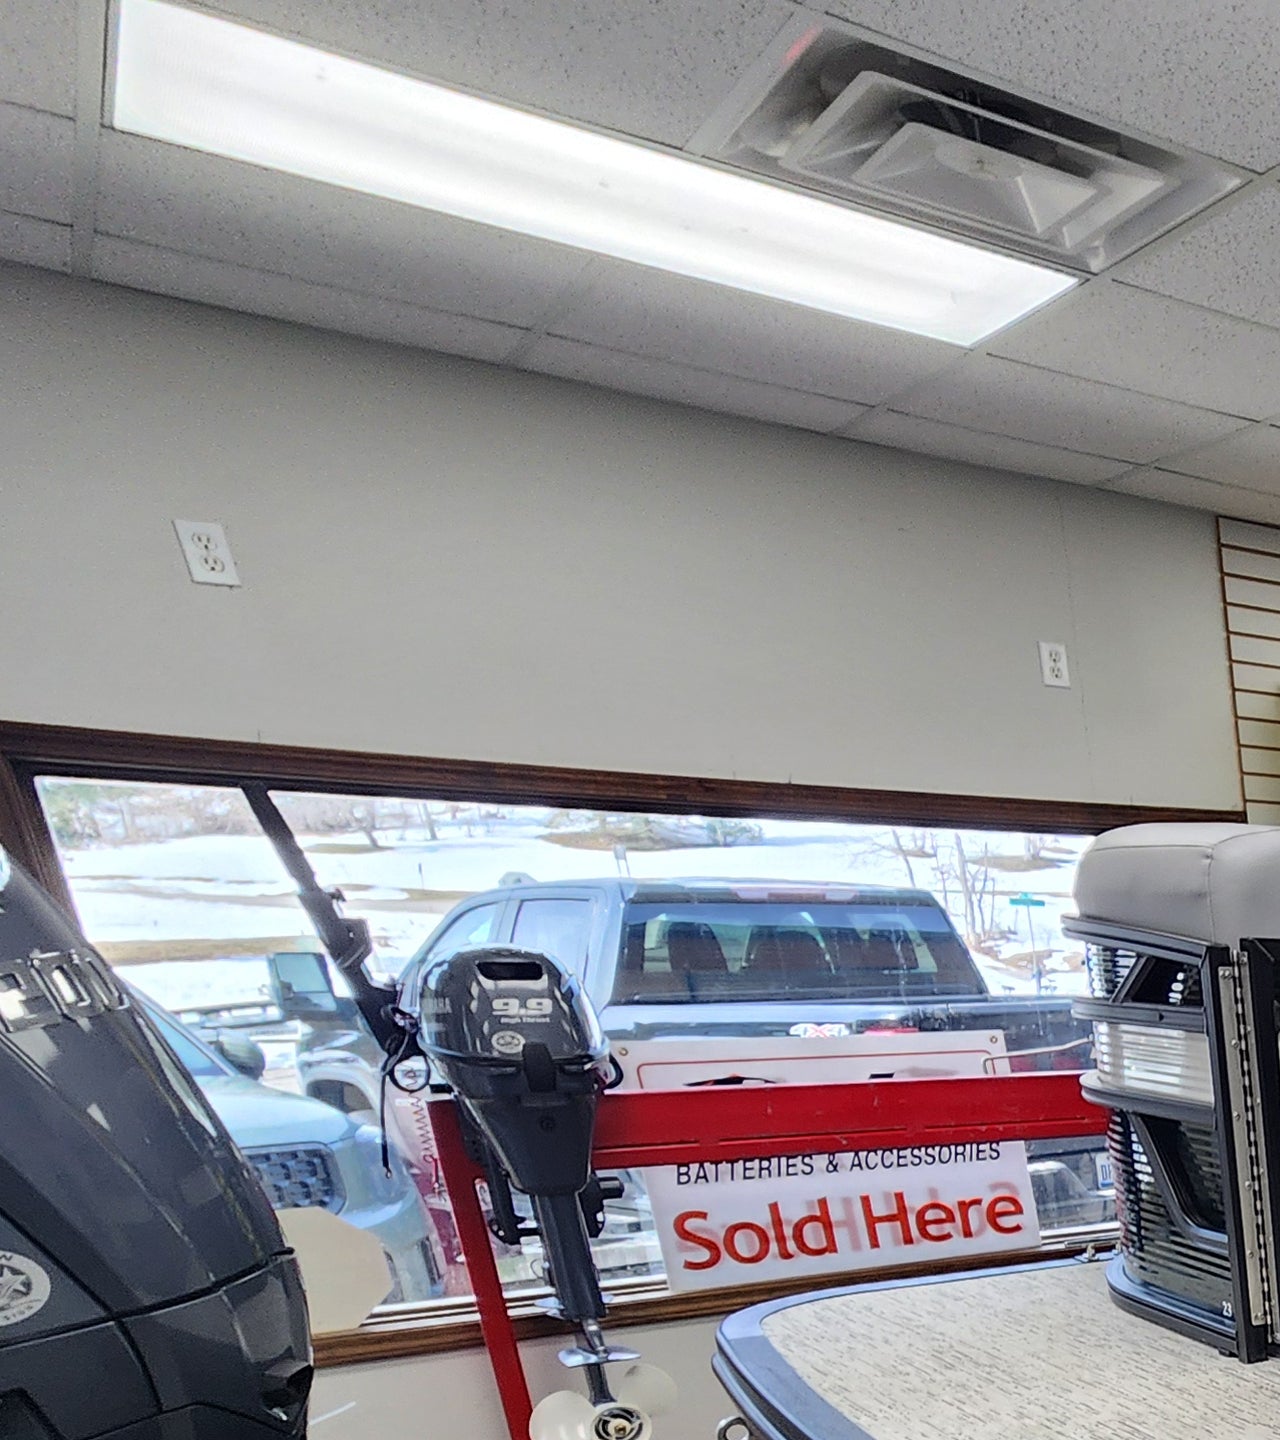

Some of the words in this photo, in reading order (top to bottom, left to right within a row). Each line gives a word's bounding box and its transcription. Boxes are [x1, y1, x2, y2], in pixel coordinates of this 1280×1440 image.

[492, 998, 553, 1015] 9.9
[676, 1154, 814, 1185] BATTERIES
[825, 1153, 840, 1174] &
[849, 1142, 1001, 1173] ACCESSORIES
[672, 1197, 839, 1271] Sold
[859, 1191, 1025, 1250] Here
